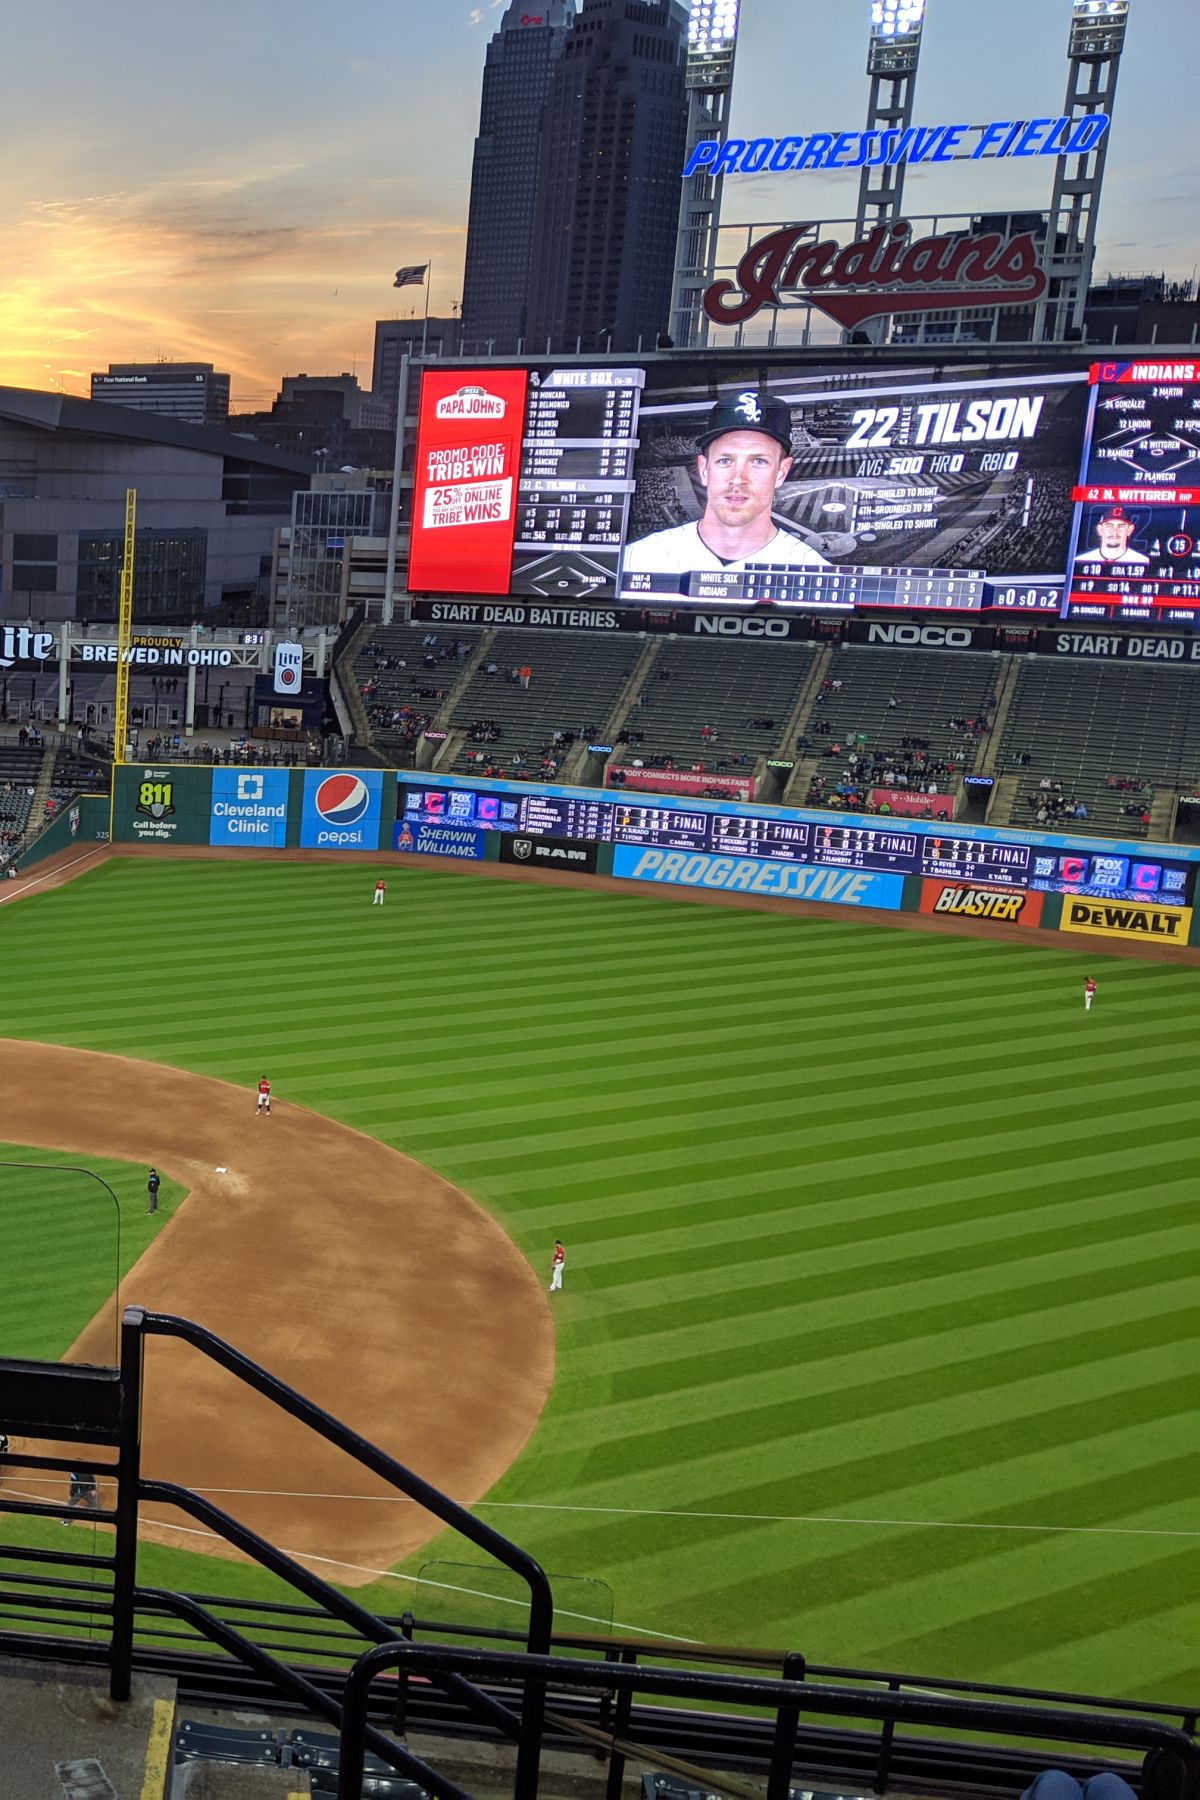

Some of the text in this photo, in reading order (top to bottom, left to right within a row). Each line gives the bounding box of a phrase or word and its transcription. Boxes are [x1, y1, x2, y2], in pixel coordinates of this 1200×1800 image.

[682, 113, 1110, 177] PROGRESSIVE FIELD
[702, 219, 1047, 332] Indians
[553, 372, 613, 386] WHITE SOX
[1132, 364, 1195, 380] INDIANS
[1160, 388, 1184, 396] MARTIN
[440, 398, 502, 414] PAPA JOHN'S
[846, 396, 1045, 448] 22 CHARLIE TILSON
[1150, 441, 1180, 450] WITTGREN
[428, 446, 468, 465] PROMO
[979, 452, 1020, 472] RBI 0
[427, 456, 504, 482] TRIBEWIN
[856, 456, 925, 476] AVG .500
[929, 454, 965, 474] HR 0
[464, 488, 502, 503] ONLINE
[907, 488, 916, 497] TO
[917, 486, 938, 497] RIGHT
[1088, 490, 1176, 501] 62 N. WITTGREN
[464, 502, 502, 522] WINS
[913, 503, 922, 512] TO
[432, 511, 462, 526] TRIBE
[902, 520, 912, 530] TO
[913, 518, 938, 530] SHORT
[1174, 540, 1185, 550] 15
[700, 572, 738, 584] WHITE SOX
[1112, 566, 1144, 576] ERA 1.59
[699, 586, 728, 596] INDIANS
[1006, 588, 1016, 606] 0
[1026, 590, 1036, 606] 0
[1047, 590, 1058, 608] 2
[432, 604, 620, 628] START DEAD BATTERIES.
[694, 615, 790, 637] NOCO
[134, 636, 182, 646] PROUDLY
[244, 634, 264, 644] 8:31
[868, 624, 972, 647] NOCO
[1056, 634, 1122, 656] START
[1127, 638, 1180, 660] DEAD
[83, 645, 232, 666] BREWED IN OHIO
[278, 652, 301, 668] Lite
[766, 760, 794, 768] NOCO
[642, 770, 750, 786] CONNECTS MORE FANS
[140, 782, 172, 806] 811
[450, 793, 472, 804] FOX
[213, 802, 285, 817] Cleveland
[450, 806, 470, 816] GO
[132, 821, 177, 830] Call before
[227, 819, 270, 834] Clinic
[674, 816, 704, 831] FINAL
[154, 830, 172, 838] dig.
[318, 830, 362, 845] pepsi
[418, 826, 476, 844] SHERWIN
[774, 826, 806, 841] FINAL
[880, 838, 912, 852] FINAL
[536, 846, 586, 860] RAM
[992, 848, 1026, 864] FINAL
[1036, 858, 1053, 866] FOX
[1094, 858, 1124, 870] FOX
[632, 850, 873, 902] PROGRESSIVE
[1094, 875, 1121, 886] GO
[934, 886, 1024, 920] BLASTER
